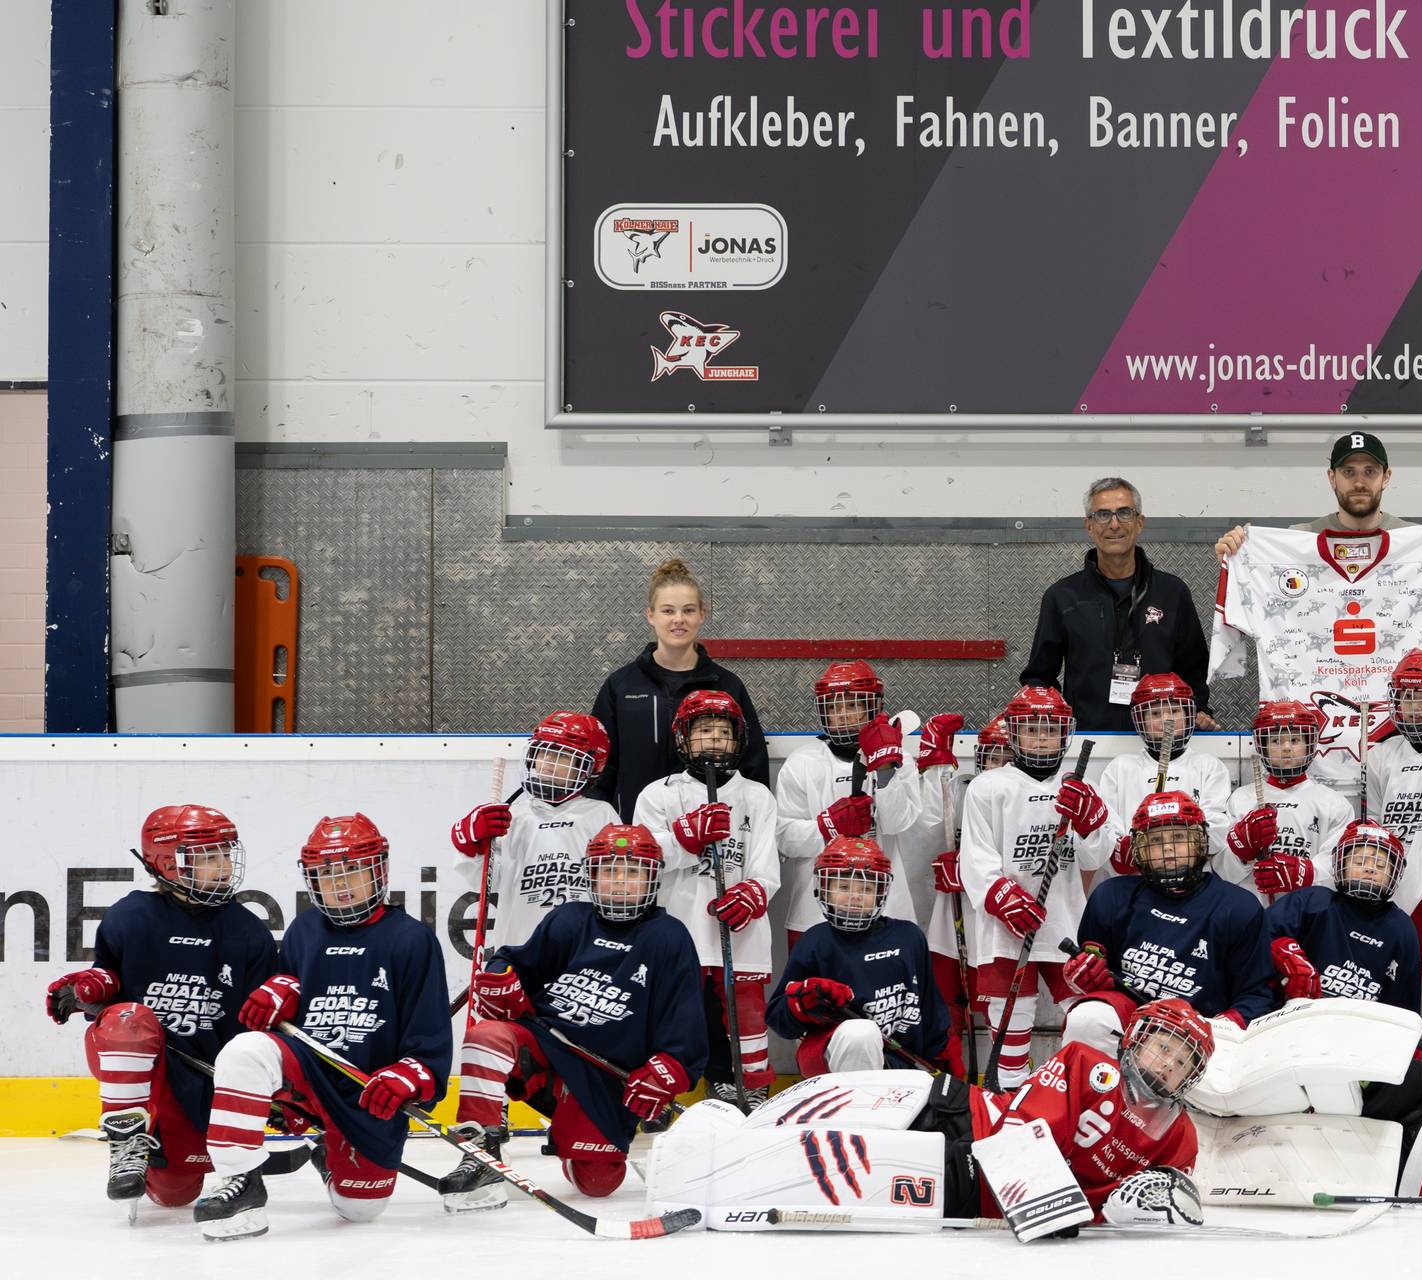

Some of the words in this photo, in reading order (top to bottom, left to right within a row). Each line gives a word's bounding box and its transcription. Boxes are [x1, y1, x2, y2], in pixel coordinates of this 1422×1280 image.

[626, 0, 879, 59] Stickerei
[921, 0, 1032, 60] und
[1081, 0, 1410, 60] Textildruck
[652, 96, 866, 157] Aufkleber,
[896, 97, 1060, 157] Fahnen,
[1089, 98, 1249, 157] Banner,
[1278, 98, 1400, 148] Folien
[614, 219, 651, 232] KÖLNER
[655, 220, 678, 232] HAIE
[698, 236, 776, 254] JONAS
[688, 281, 728, 289] PARTNER
[708, 369, 755, 378] JUNGHAIE
[1350, 434, 1364, 448] B
[1317, 664, 1393, 678] Kreissparkasse
[1332, 714, 1376, 728] KEC
[538, 820, 574, 830] CCM
[523, 861, 581, 878] GOALS
[540, 889, 567, 908] 25
[1150, 907, 1188, 925] CCM
[168, 936, 213, 948] CCM
[593, 938, 633, 952] CCM
[1350, 930, 1384, 948] CCM
[325, 946, 367, 956] CCM
[864, 948, 901, 962] CCM
[1122, 947, 1184, 975] GOALS
[1184, 967, 1197, 979] &
[736, 974, 768, 982] CCM
[1120, 959, 1197, 993] DREAMS
[1324, 964, 1381, 994] GOALS
[558, 973, 621, 1000] GOALS
[558, 1003, 593, 1026] 25
[167, 1013, 198, 1037] 25
[459, 1140, 541, 1193] BAUER
[339, 1177, 392, 1190] BAUER
[1026, 1196, 1073, 1218] BAUER
